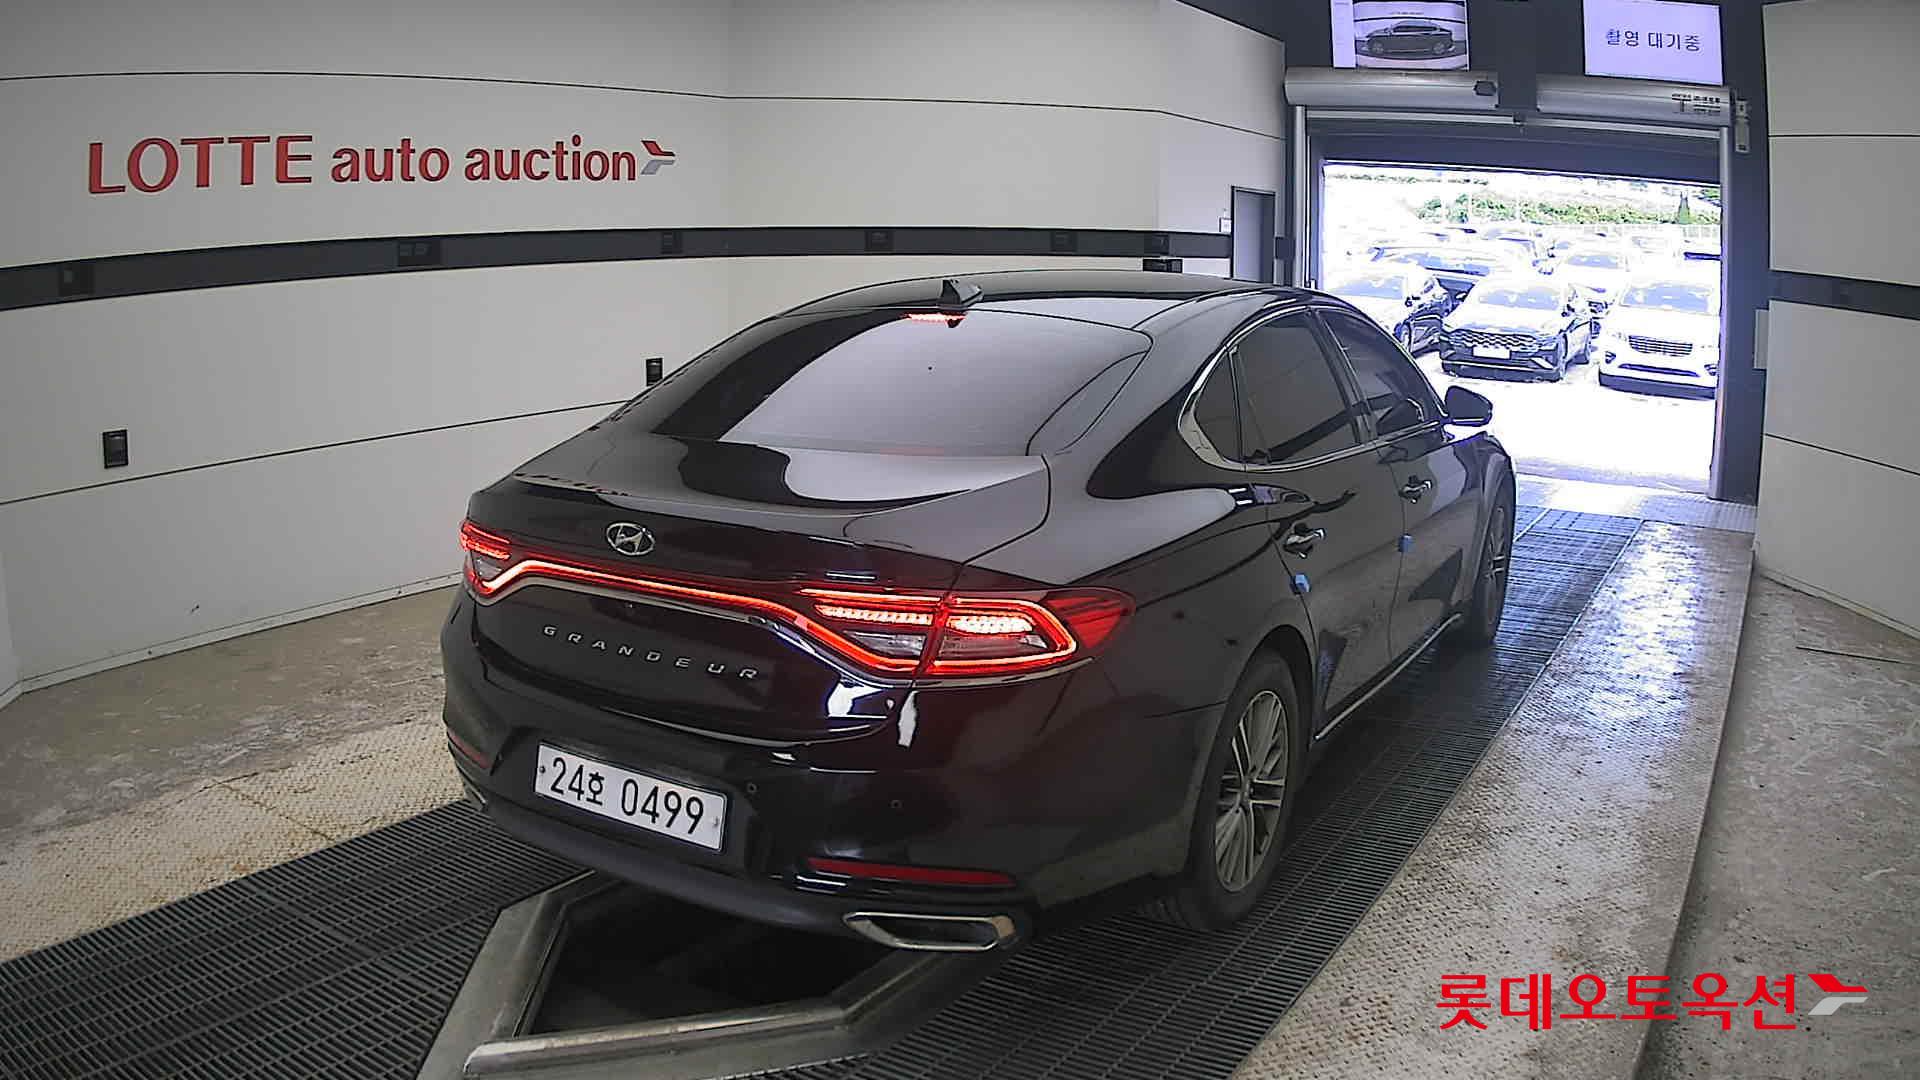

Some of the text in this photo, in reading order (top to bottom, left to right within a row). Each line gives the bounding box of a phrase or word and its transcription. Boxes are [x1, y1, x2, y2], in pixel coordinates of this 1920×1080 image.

[1648, 32, 1701, 52] 대기중
[88, 134, 636, 194] LOTTE auto auction
[543, 625, 758, 679] GRANDEUR
[550, 757, 704, 835] 24호 0499
